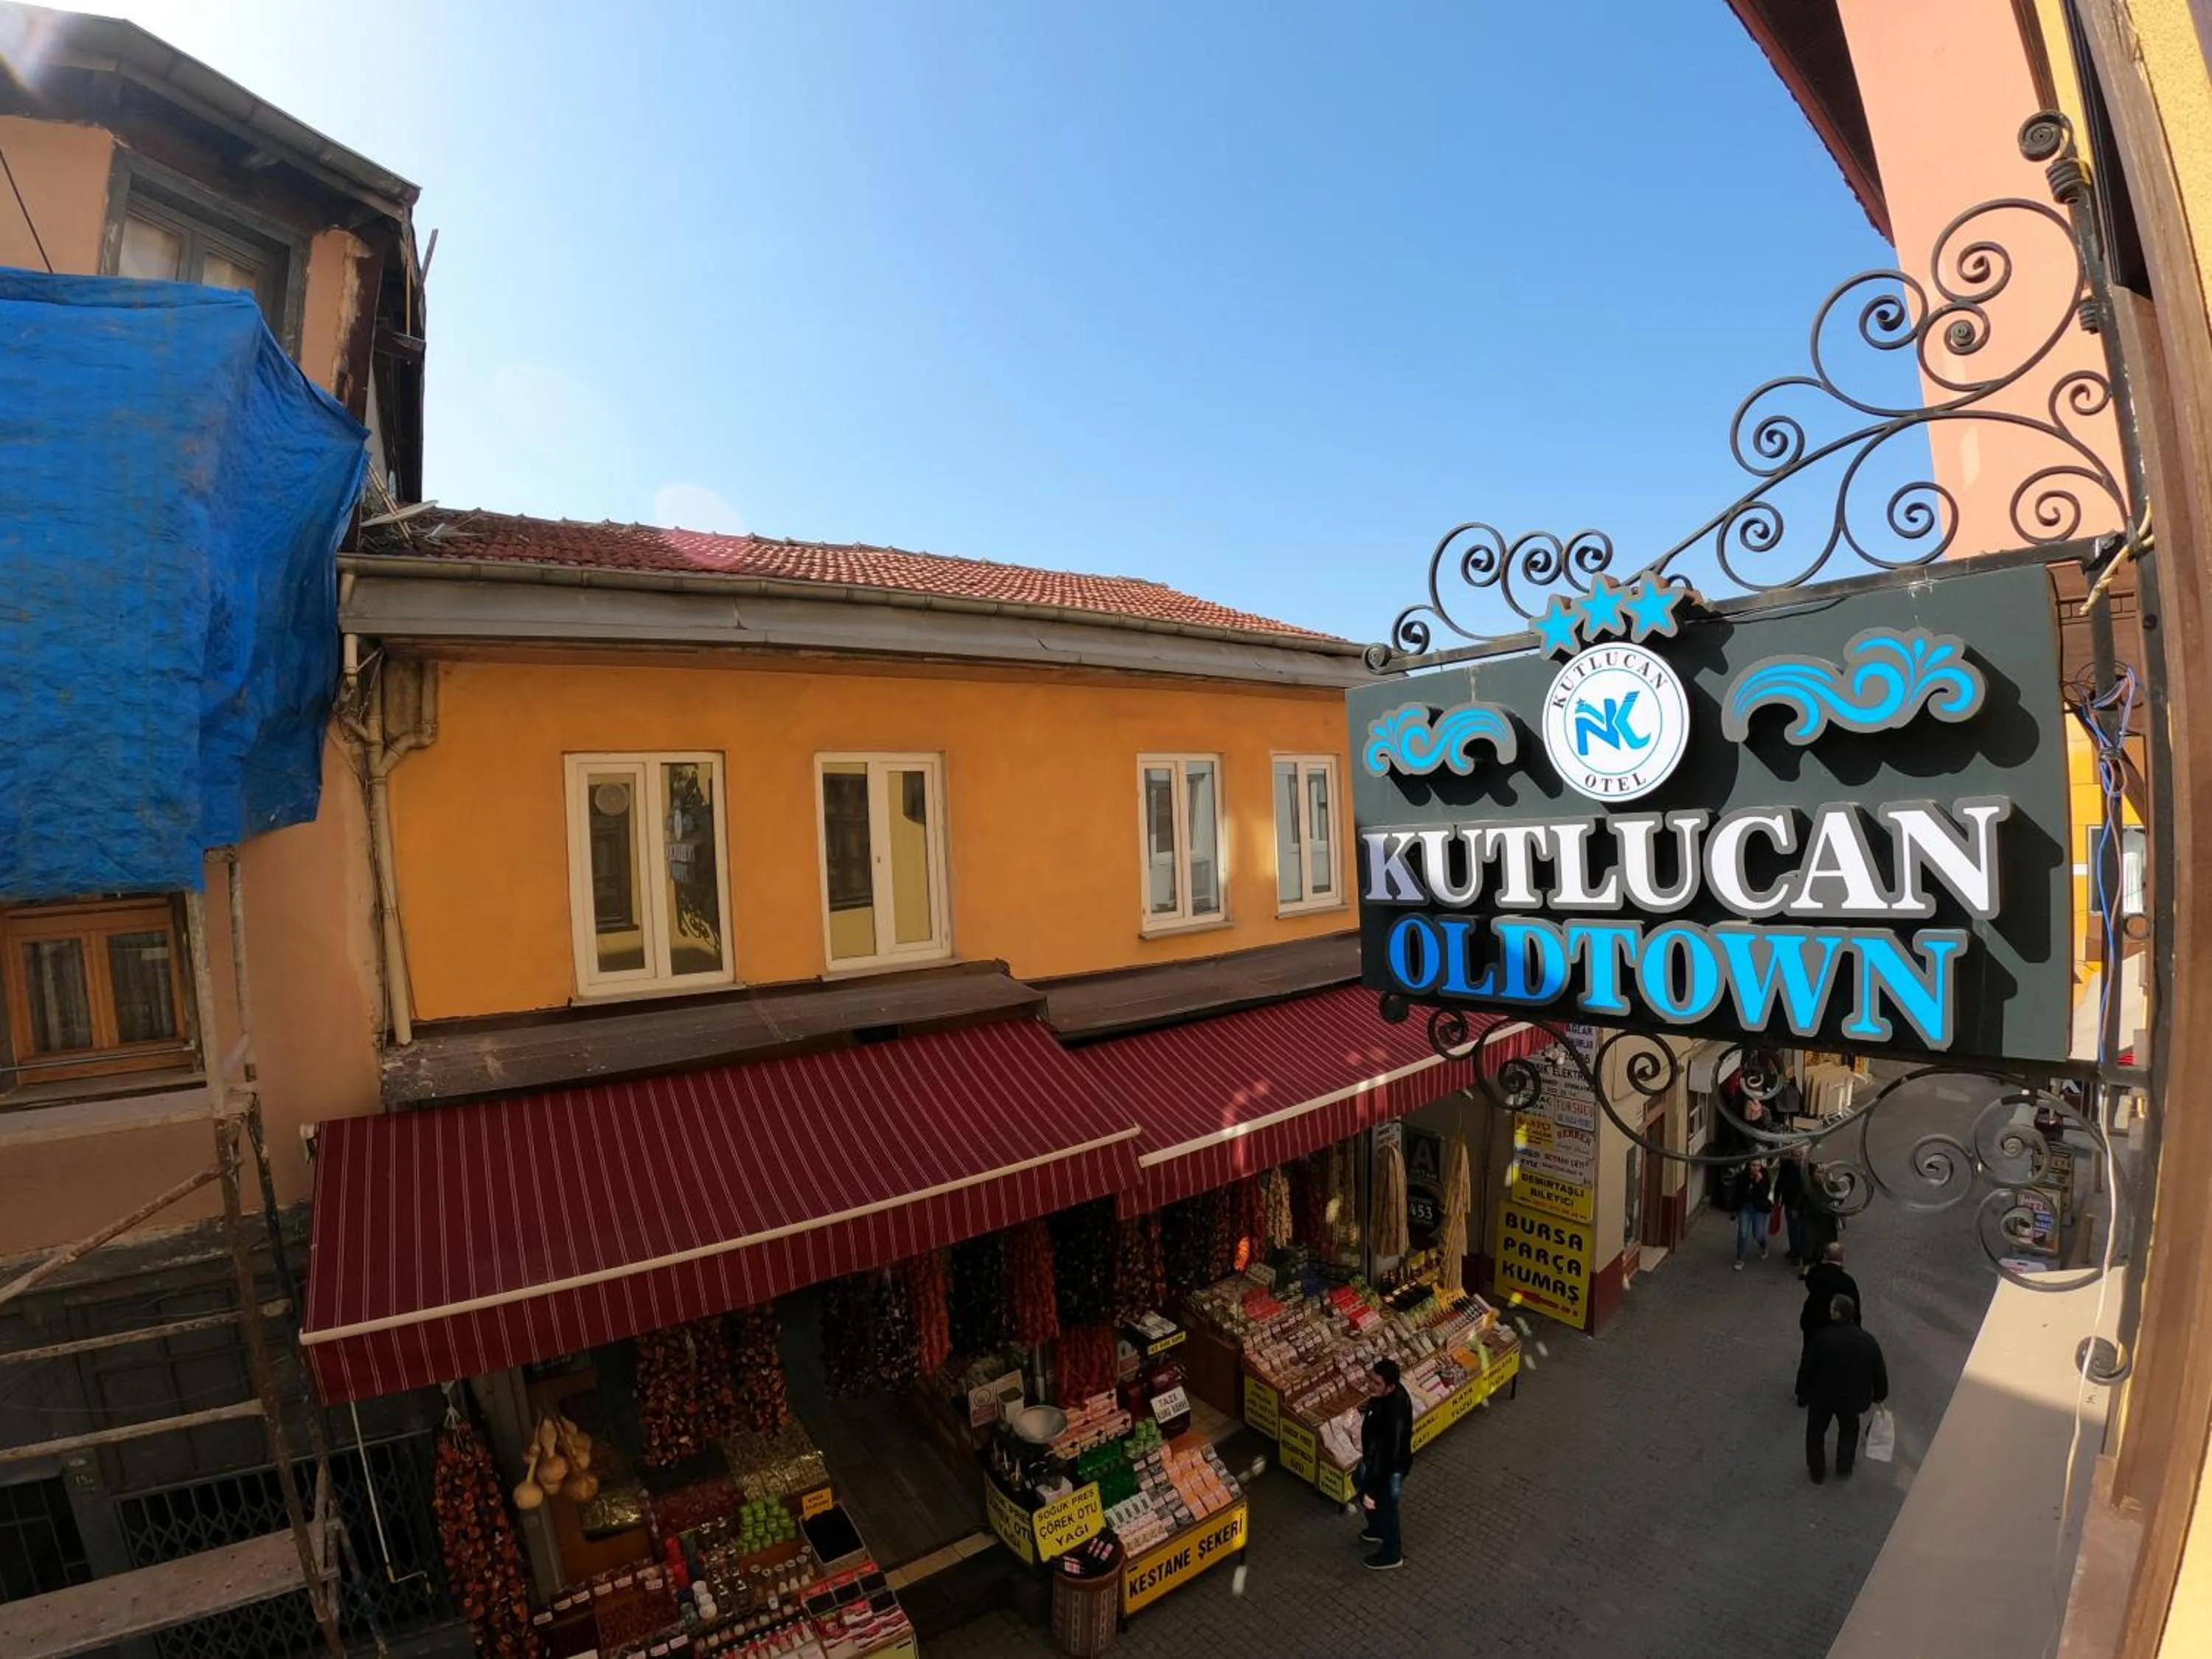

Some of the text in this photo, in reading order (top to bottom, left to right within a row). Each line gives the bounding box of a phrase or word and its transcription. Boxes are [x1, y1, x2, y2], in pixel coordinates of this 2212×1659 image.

[1553, 651, 1668, 709] KUTLUCAN
[1585, 772, 1646, 793] OTEL
[1360, 804, 2003, 913] KUTLUCAN
[1388, 918, 1961, 1043] OLDTOWN
[1505, 1211, 1583, 1251] BURSA
[1503, 1237, 1582, 1277] PARÇA
[1501, 1259, 1579, 1305] KUMAŞ
[1039, 1500, 1098, 1540] ÇÖREK OTU
[1055, 1523, 1090, 1547] YAĞI
[1129, 1512, 1242, 1599] KESTANE ŞEKERİ
